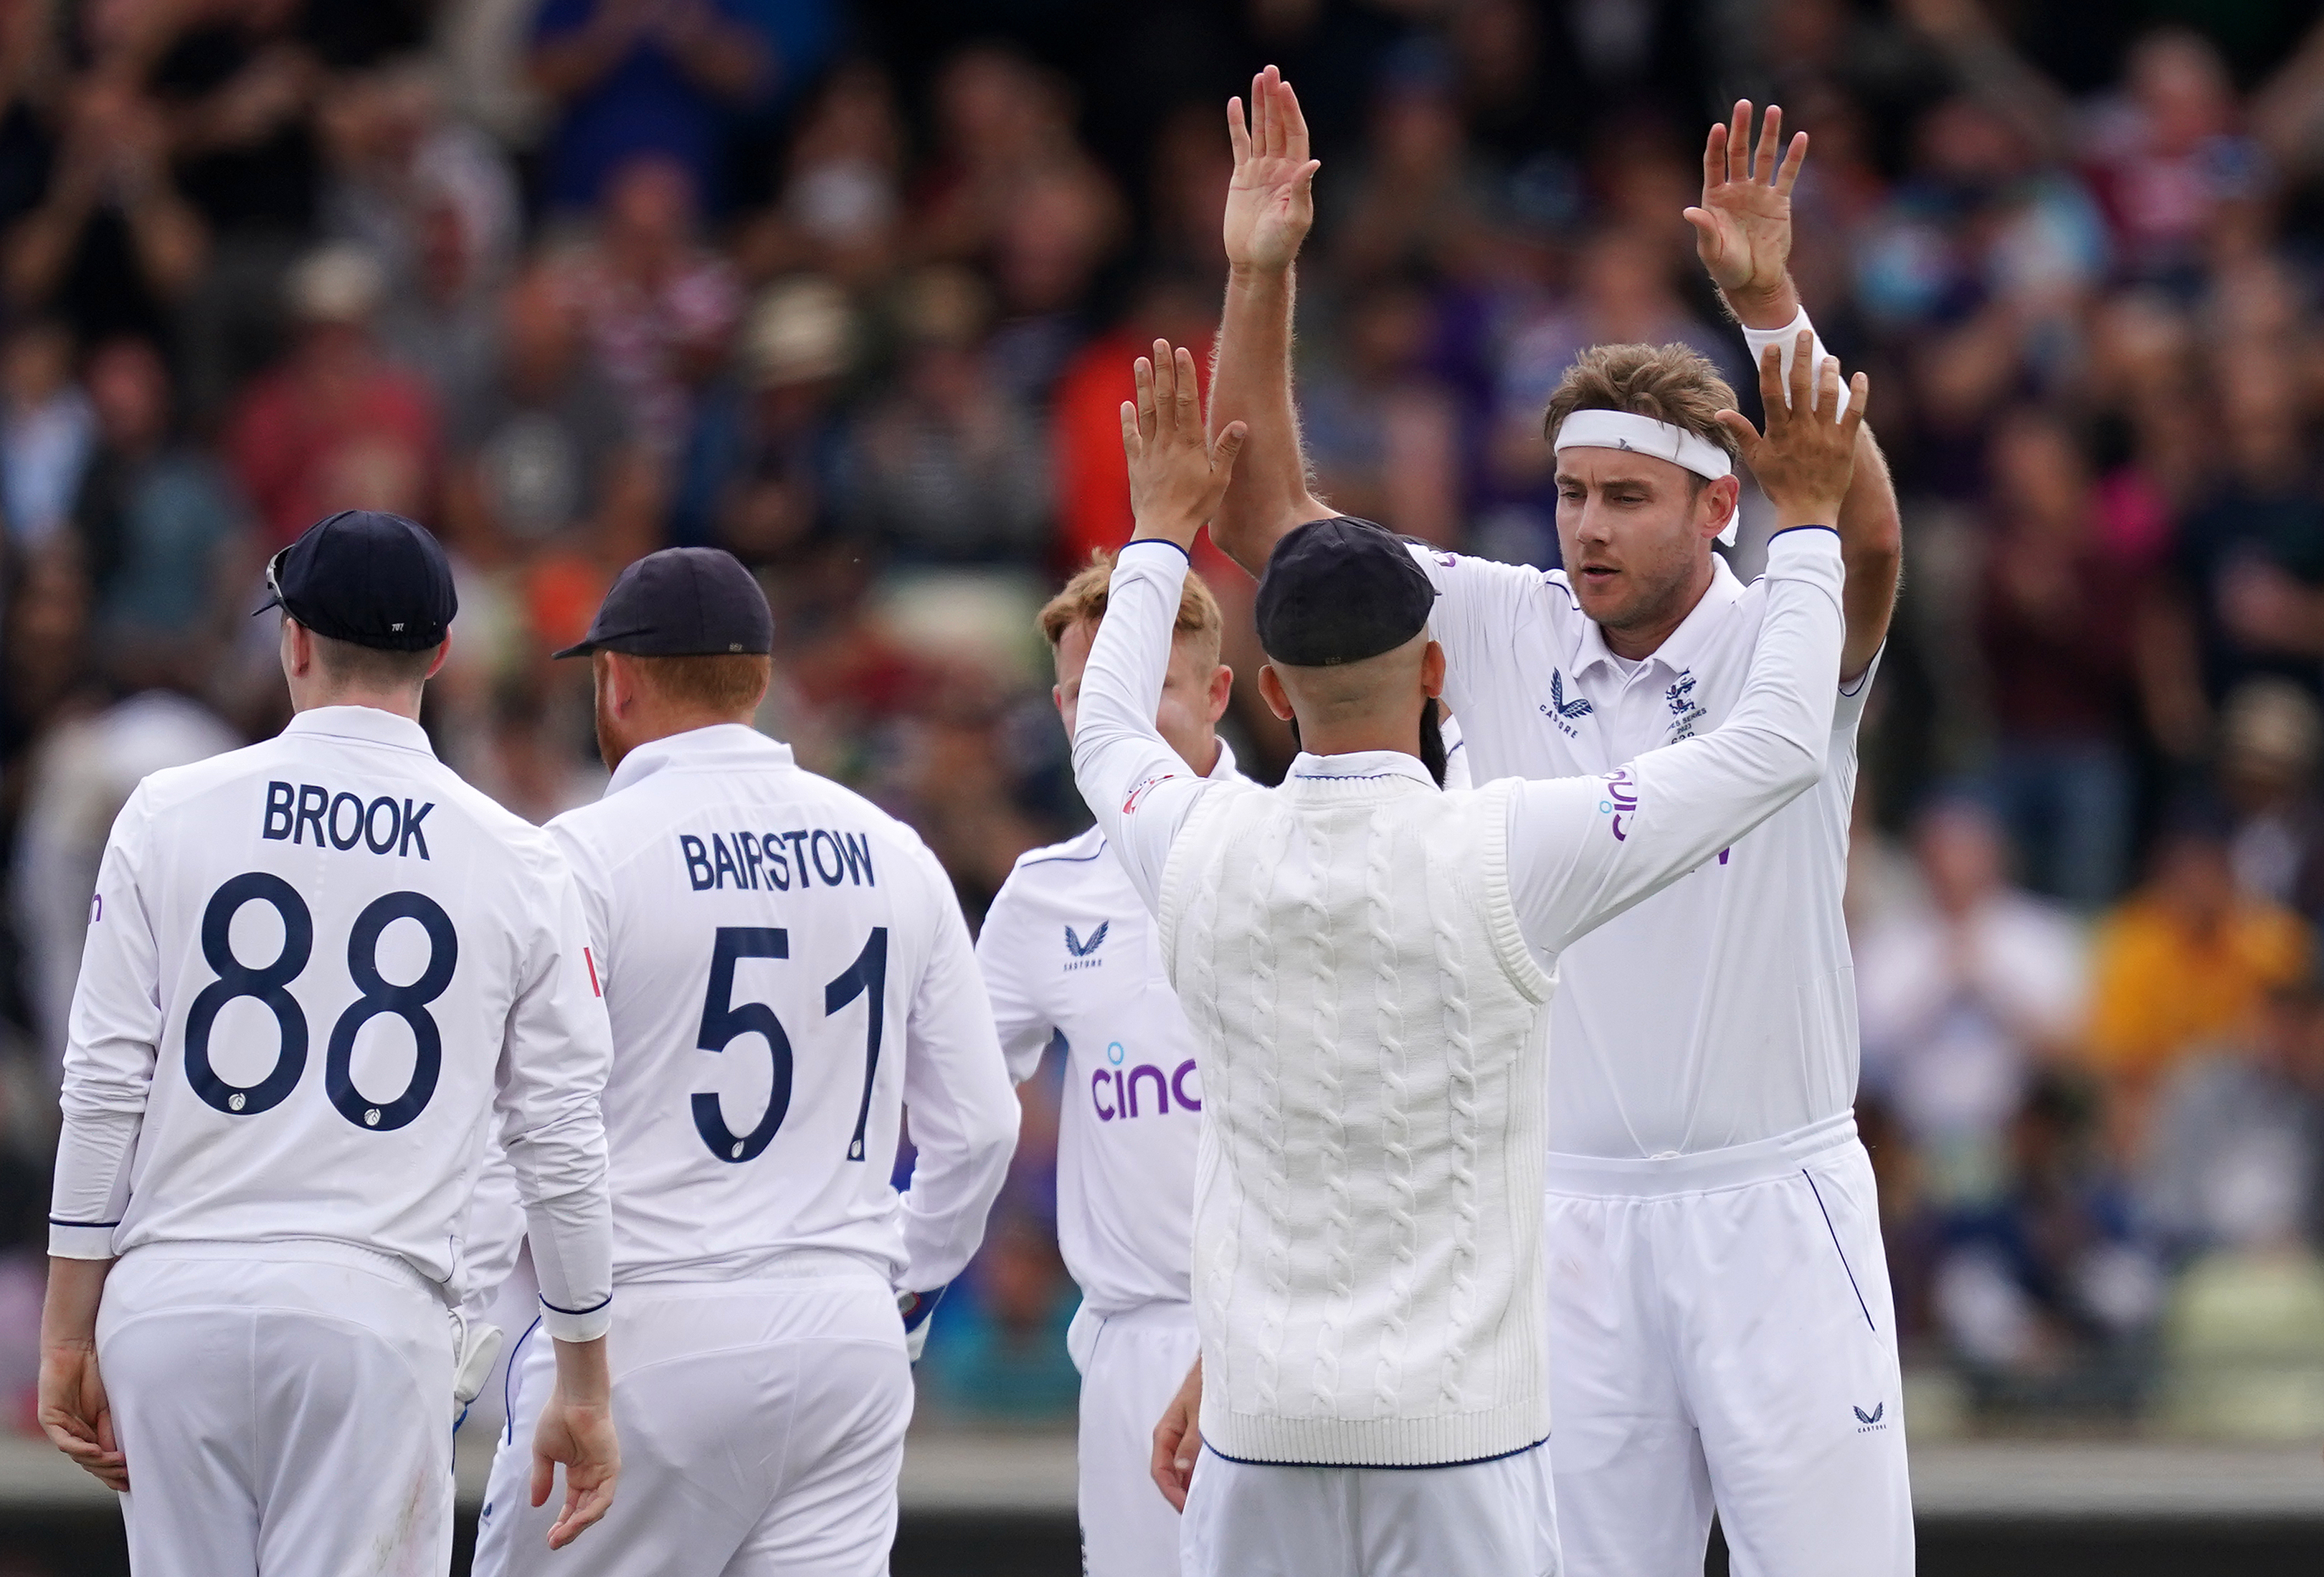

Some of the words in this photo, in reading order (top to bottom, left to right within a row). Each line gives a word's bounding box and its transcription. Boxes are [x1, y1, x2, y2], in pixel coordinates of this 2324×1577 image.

[263, 781, 435, 861] BROOK
[680, 830, 875, 891] BAIRSTOW
[185, 871, 457, 1131] 88
[691, 927, 888, 1163] 51
